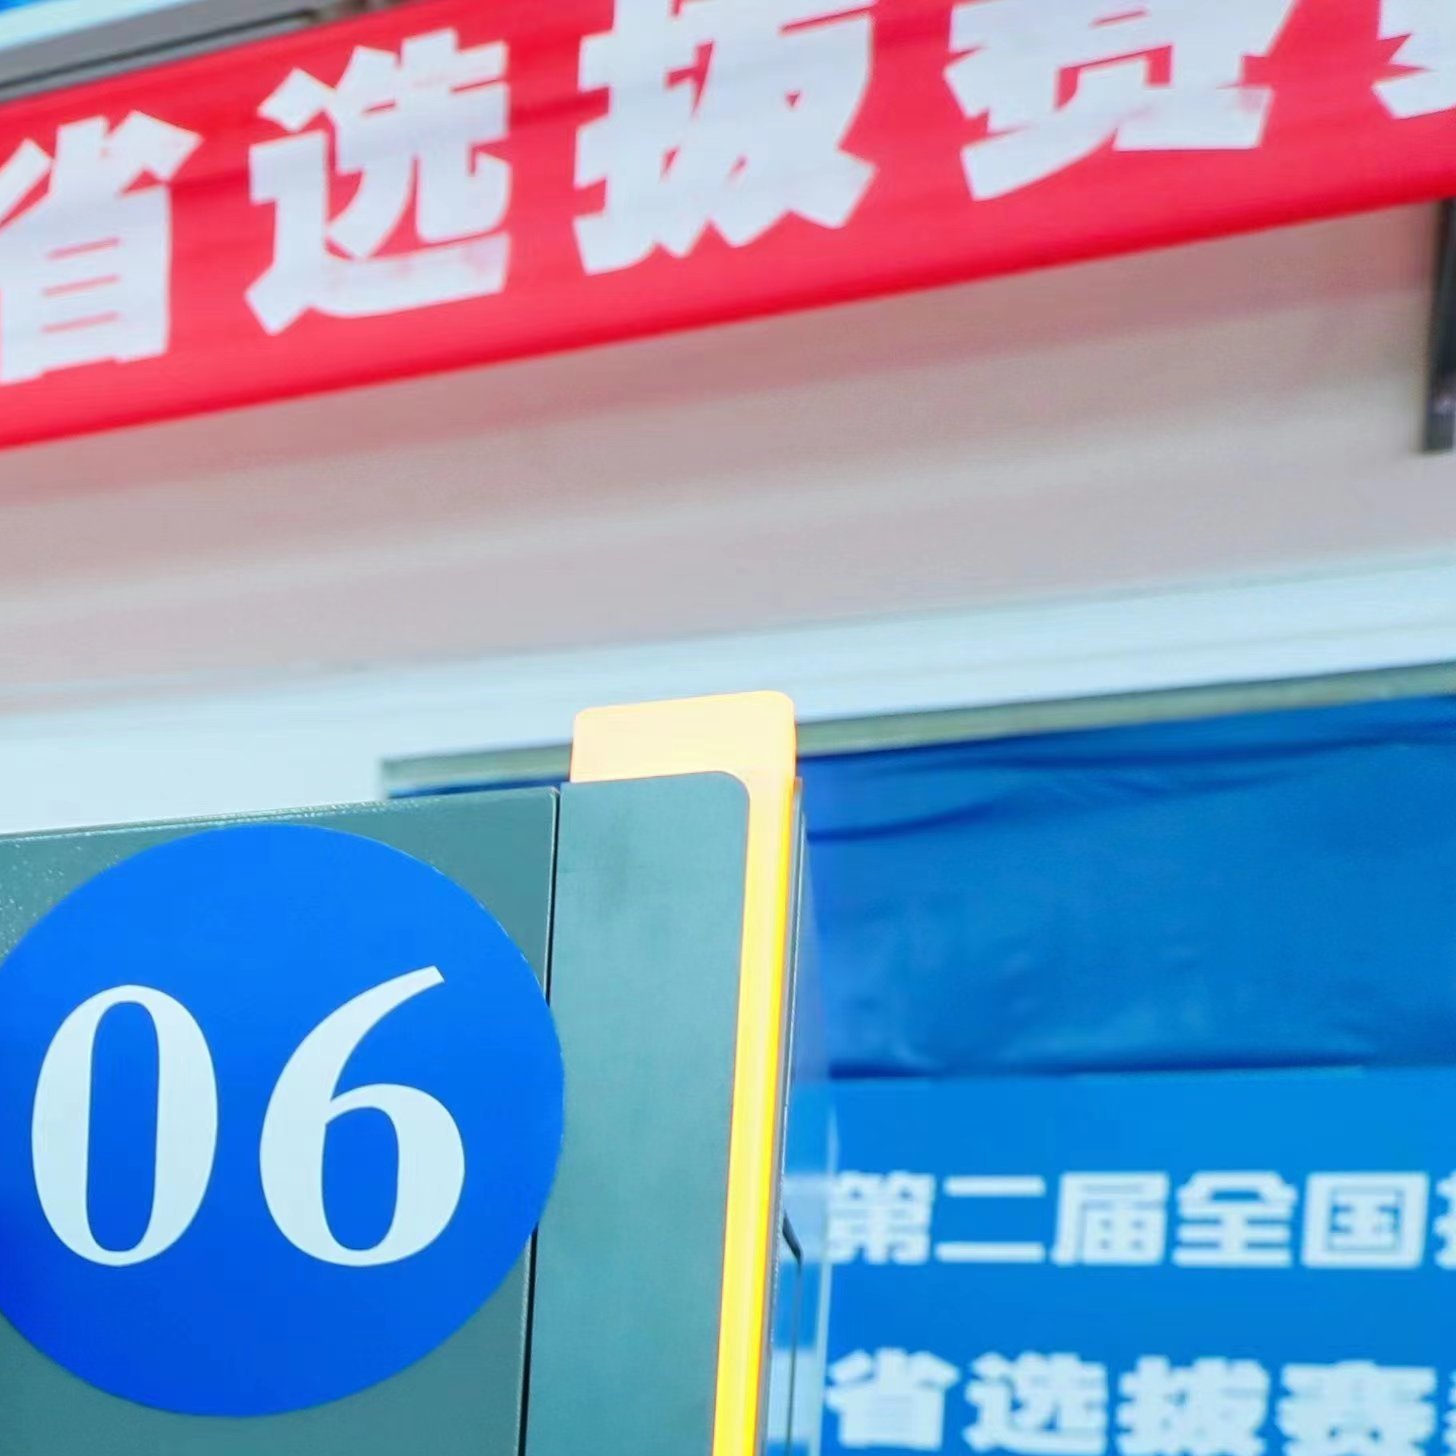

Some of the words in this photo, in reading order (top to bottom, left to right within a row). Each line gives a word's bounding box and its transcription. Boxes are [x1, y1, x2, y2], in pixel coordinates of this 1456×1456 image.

[31, 965, 466, 1268] 06
[826, 1170, 1456, 1269] 第二届全国
